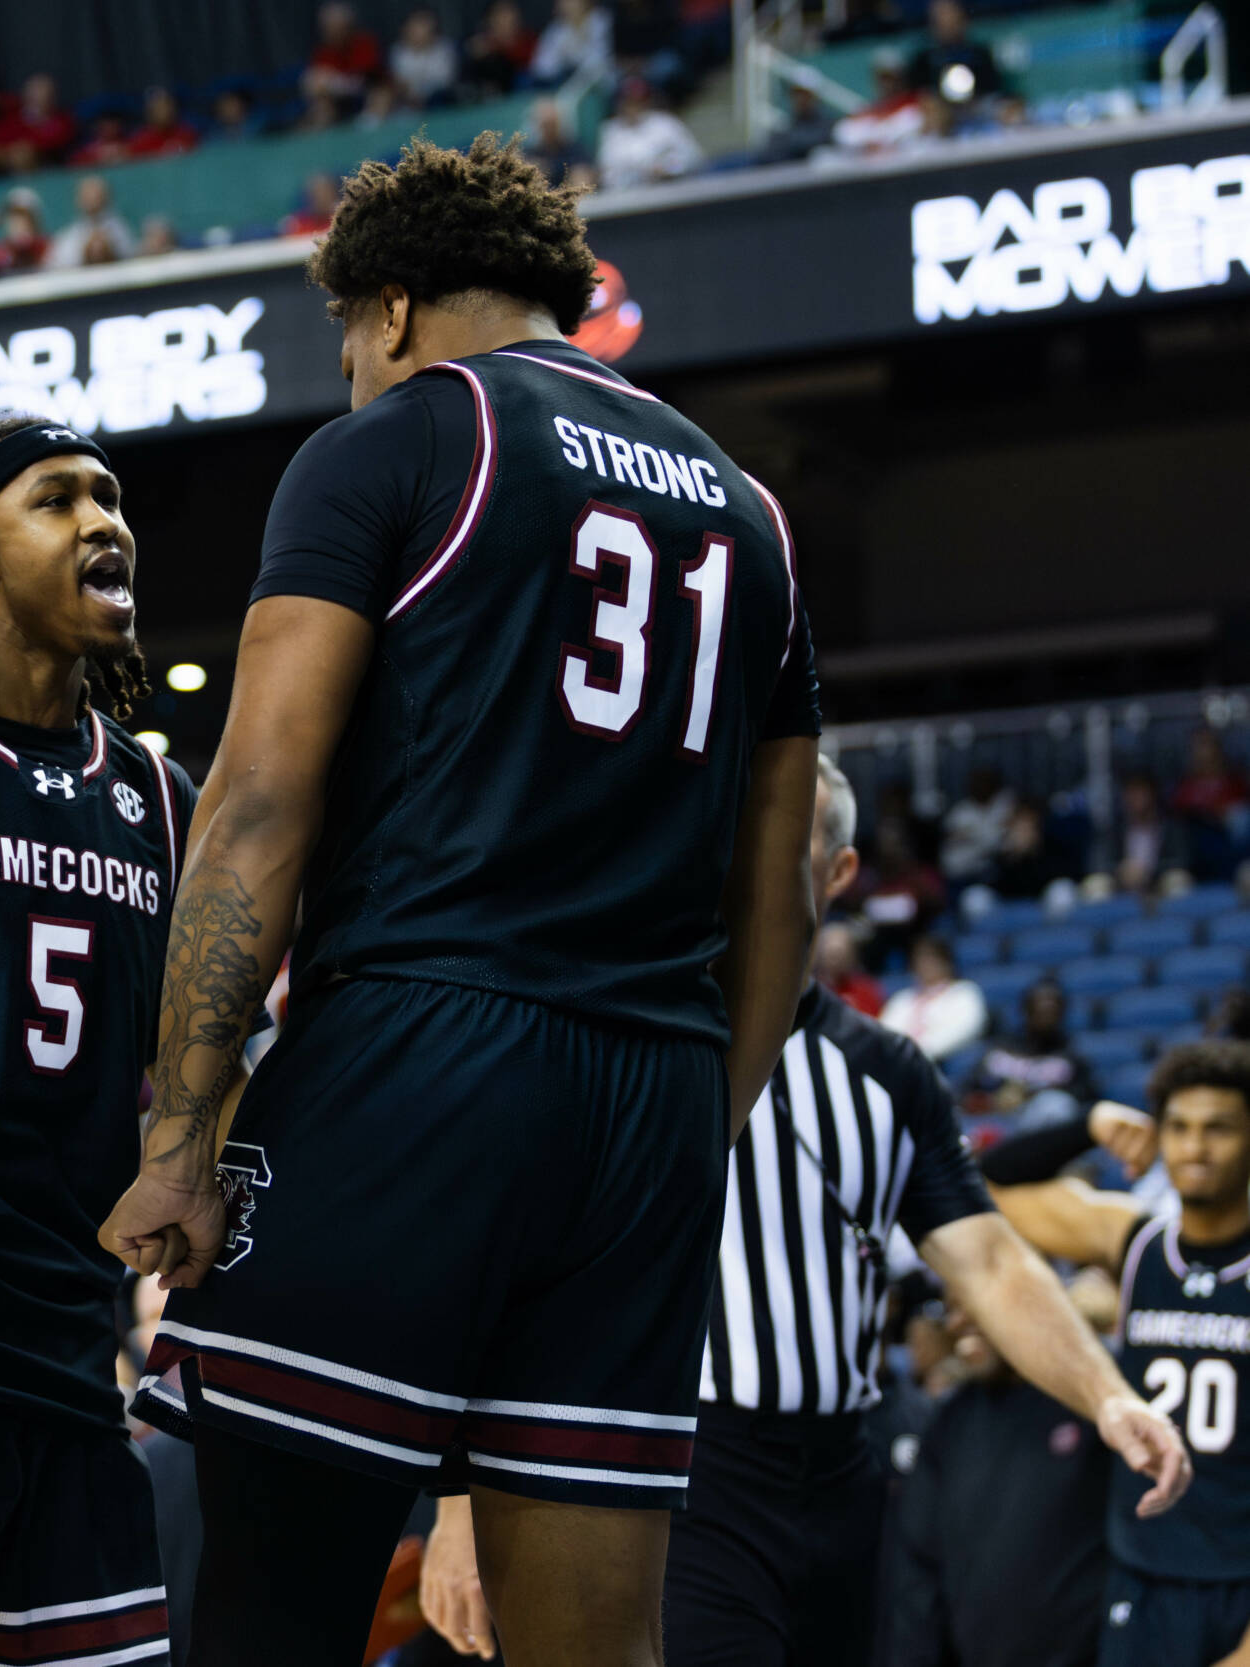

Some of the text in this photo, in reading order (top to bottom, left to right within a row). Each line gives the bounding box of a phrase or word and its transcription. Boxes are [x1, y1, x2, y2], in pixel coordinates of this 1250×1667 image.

[911, 176, 1111, 263] BAD
[89, 297, 265, 374] BOY
[553, 415, 727, 508] STRONG
[556, 499, 735, 764] 31
[112, 780, 147, 825] SEC
[24, 914, 95, 1076] 5
[1127, 1310, 1250, 1354] GAMECOCK
[1143, 1356, 1238, 1454] 20
